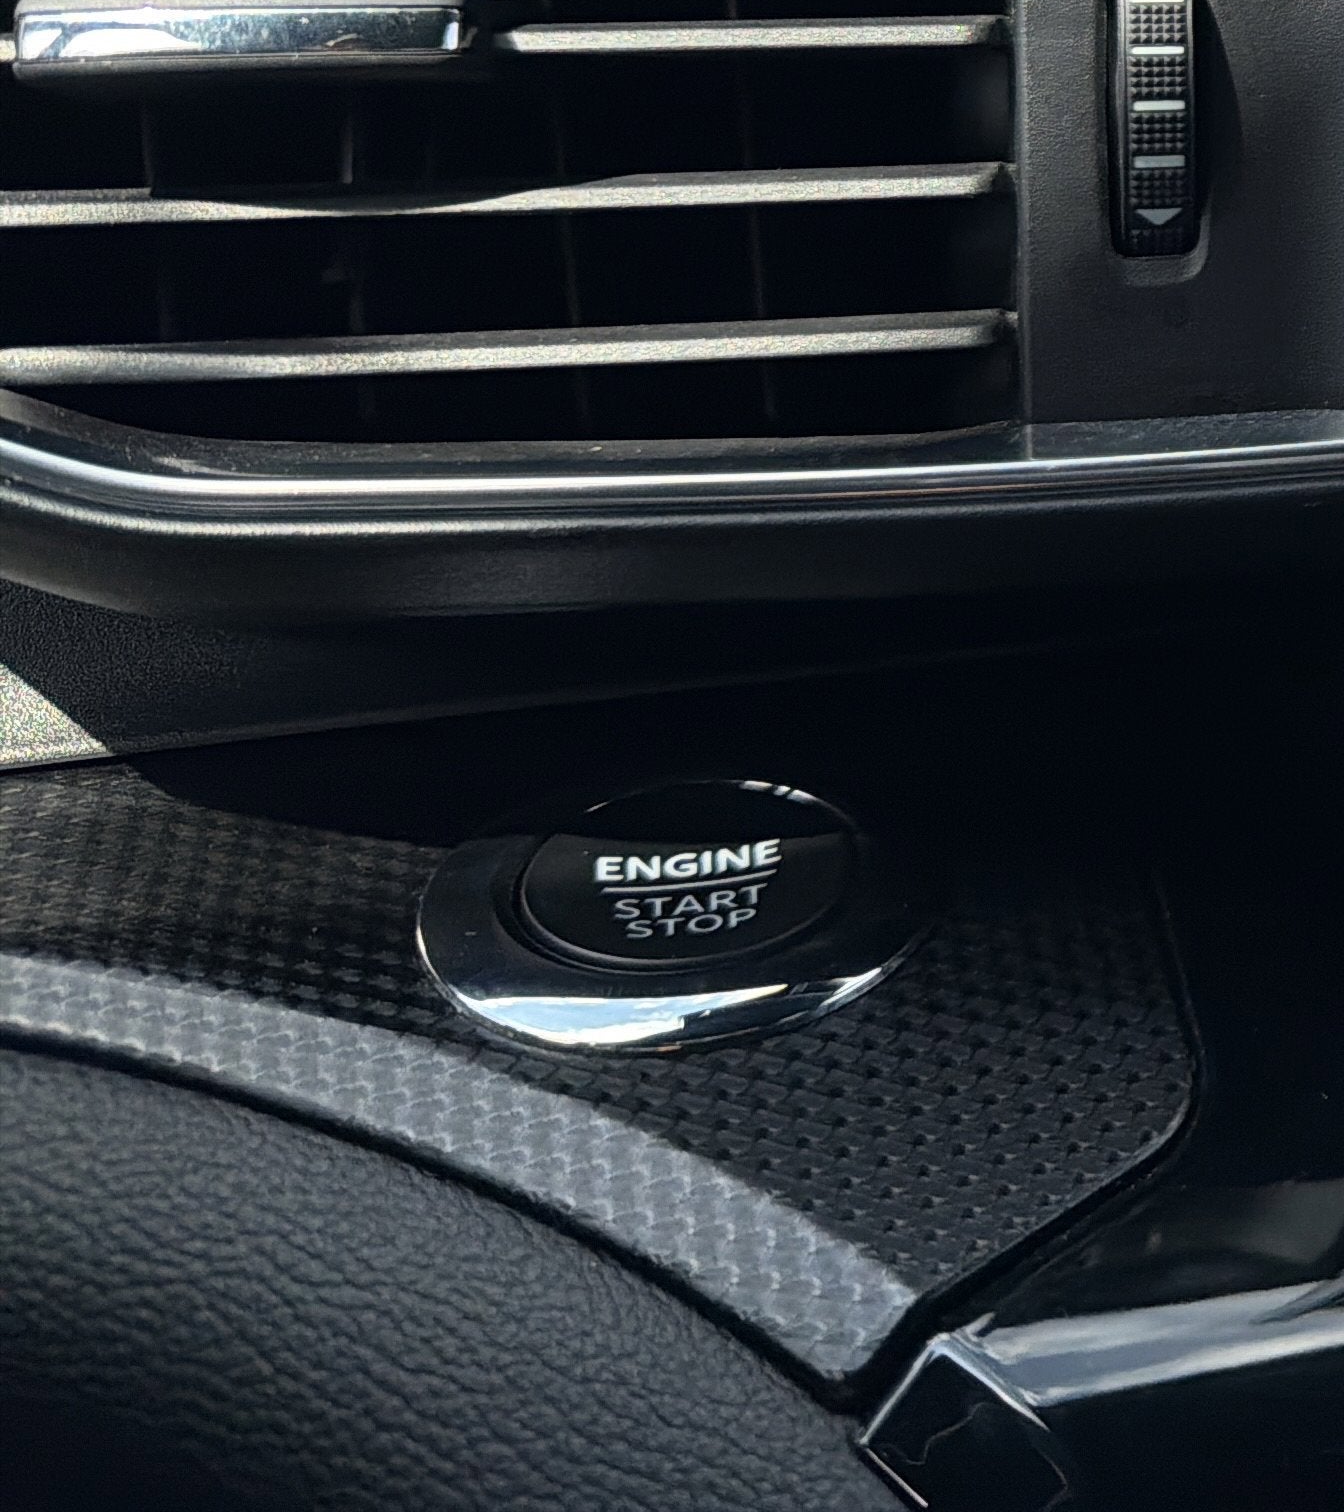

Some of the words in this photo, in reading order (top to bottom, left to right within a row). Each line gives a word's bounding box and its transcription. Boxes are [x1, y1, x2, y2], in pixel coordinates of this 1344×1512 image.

[594, 838, 782, 882] ENGINE
[612, 883, 768, 920] START
[624, 907, 758, 939] STOP
